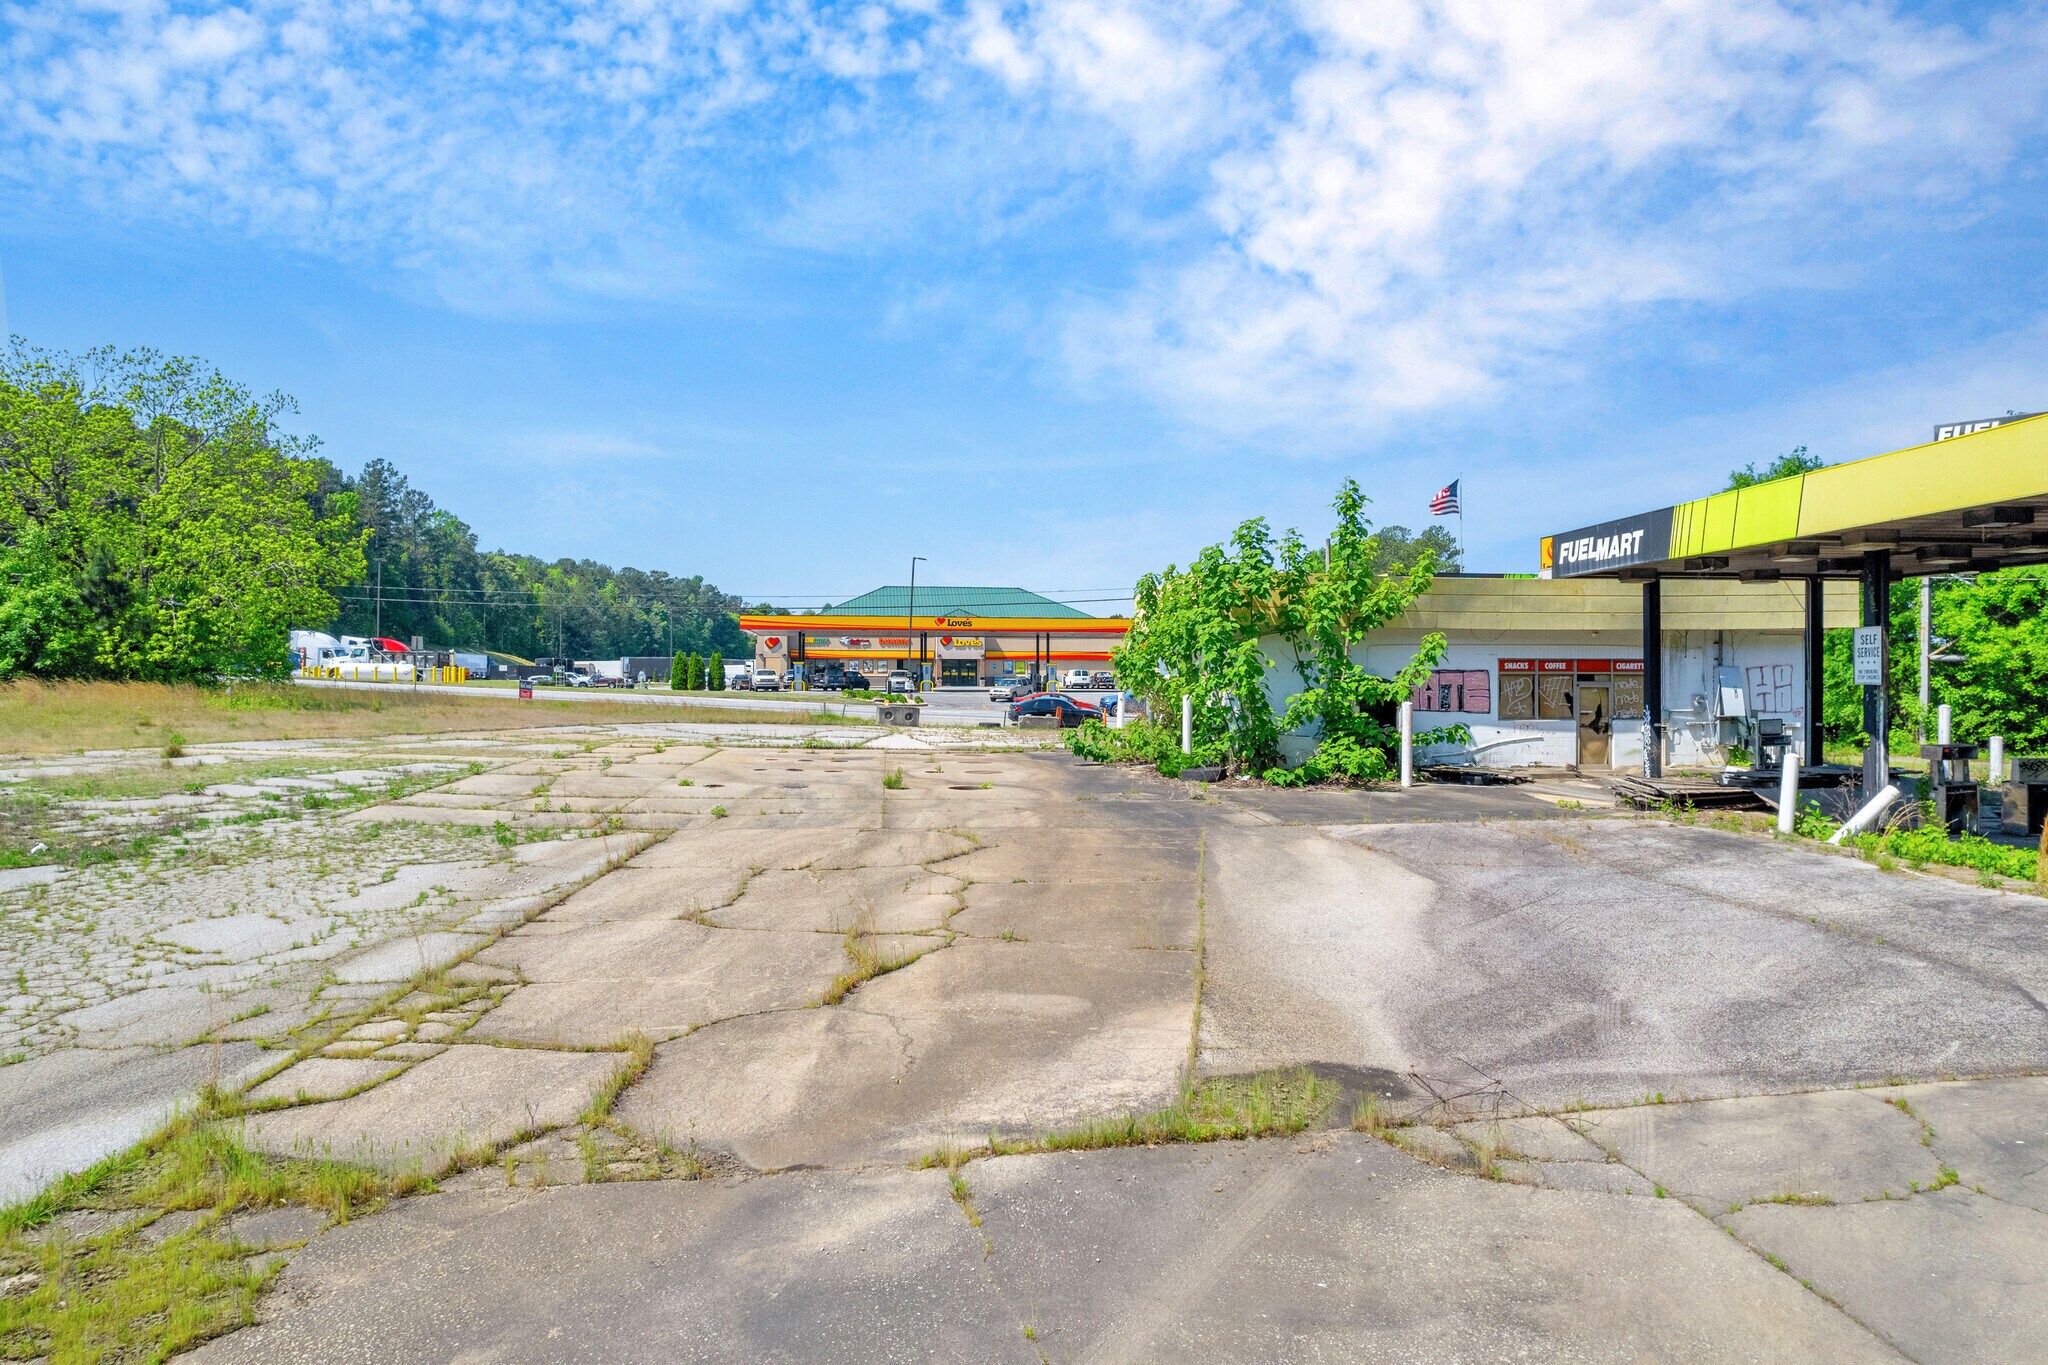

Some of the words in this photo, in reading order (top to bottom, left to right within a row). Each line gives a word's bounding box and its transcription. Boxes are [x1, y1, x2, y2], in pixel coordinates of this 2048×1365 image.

[1559, 529, 1645, 565] FUELMART
[947, 618, 972, 627] Love's
[1860, 634, 1877, 645] SELF
[1857, 646, 1880, 658] SERVICE
[1504, 662, 1529, 670] SNACKS
[1544, 662, 1567, 670] COFFEE
